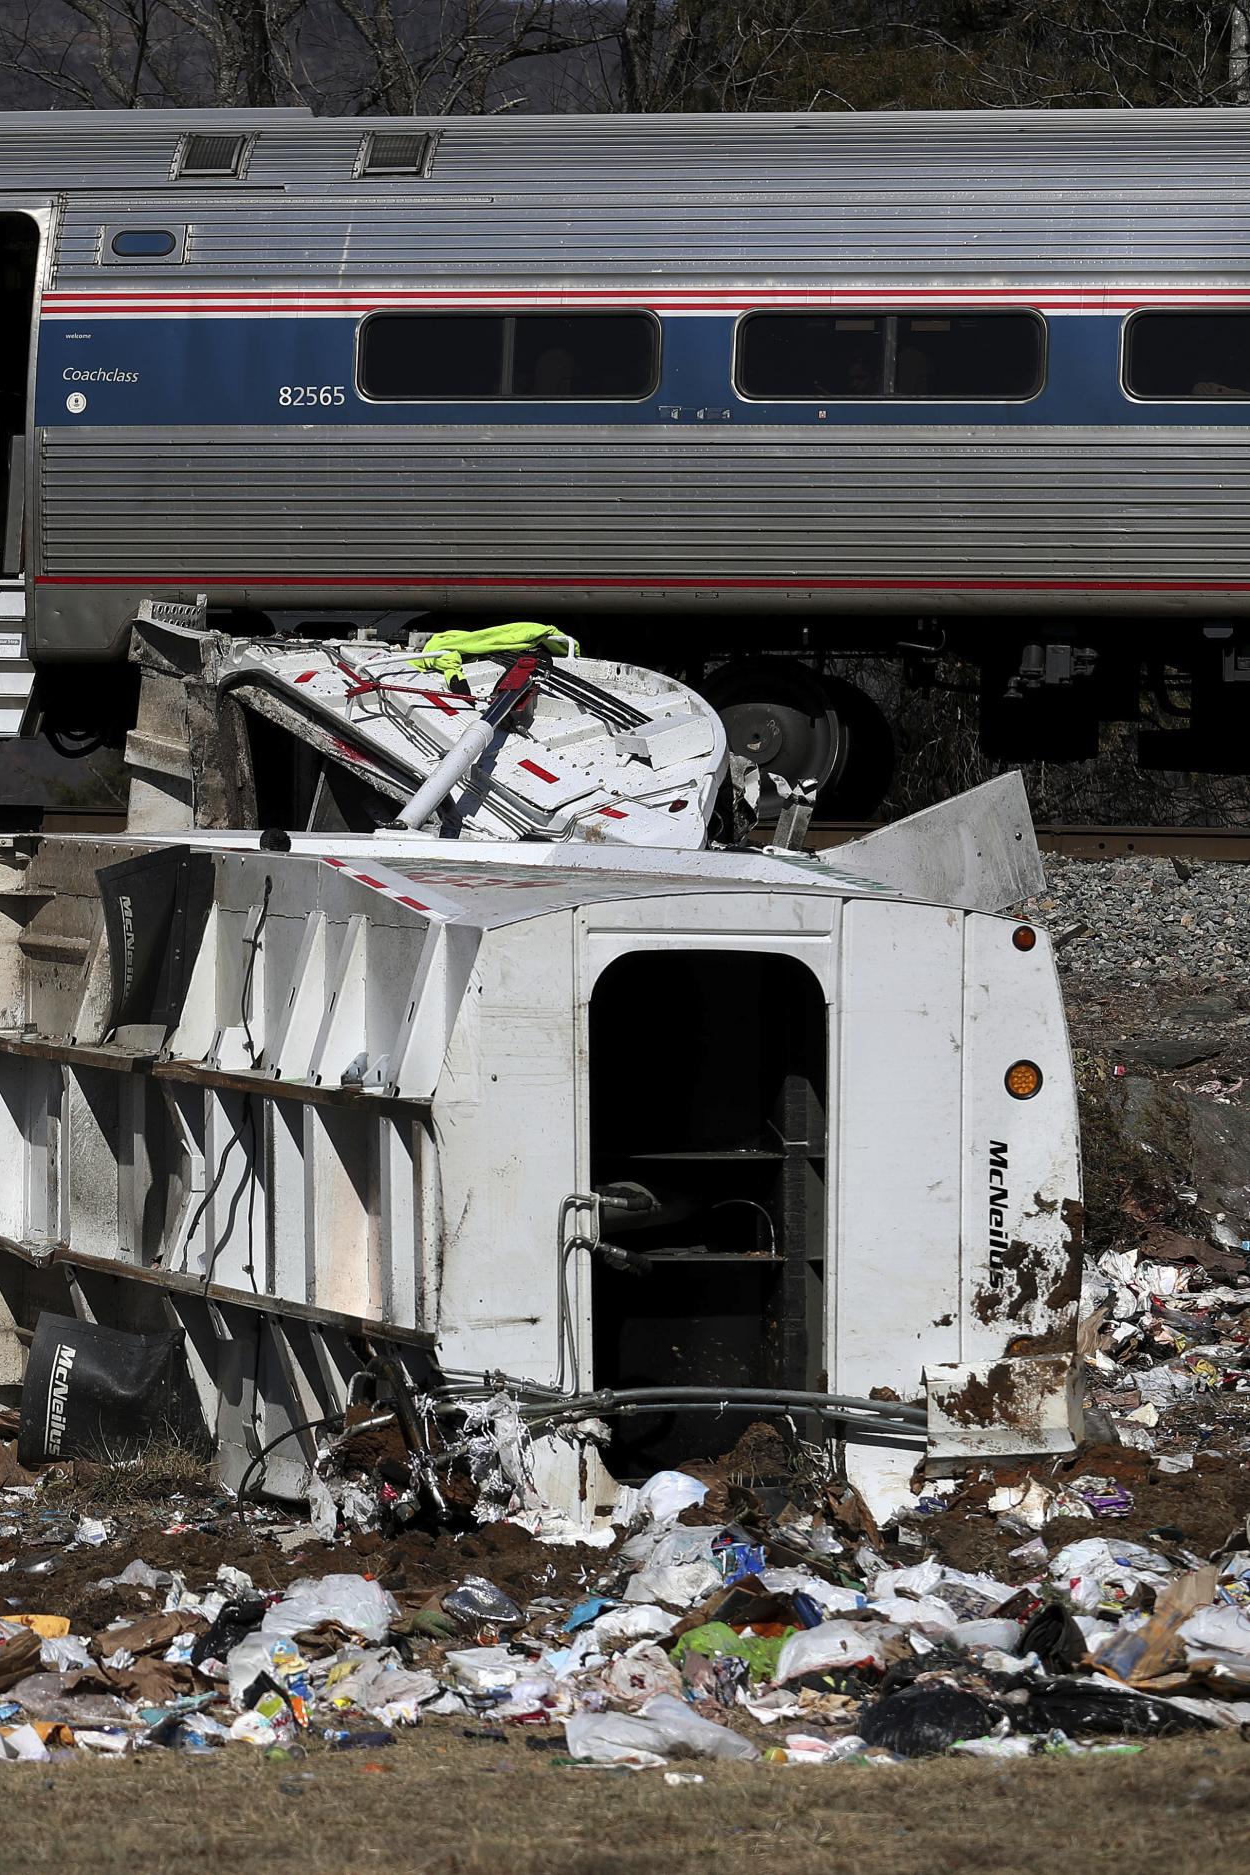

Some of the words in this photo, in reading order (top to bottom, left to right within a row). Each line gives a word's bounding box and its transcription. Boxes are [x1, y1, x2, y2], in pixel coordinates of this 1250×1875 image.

[62, 367, 139, 383] Coachclass
[278, 386, 345, 406] 82565
[989, 1139, 1009, 1290] McNeilus
[49, 1344, 77, 1457] McNeilus
